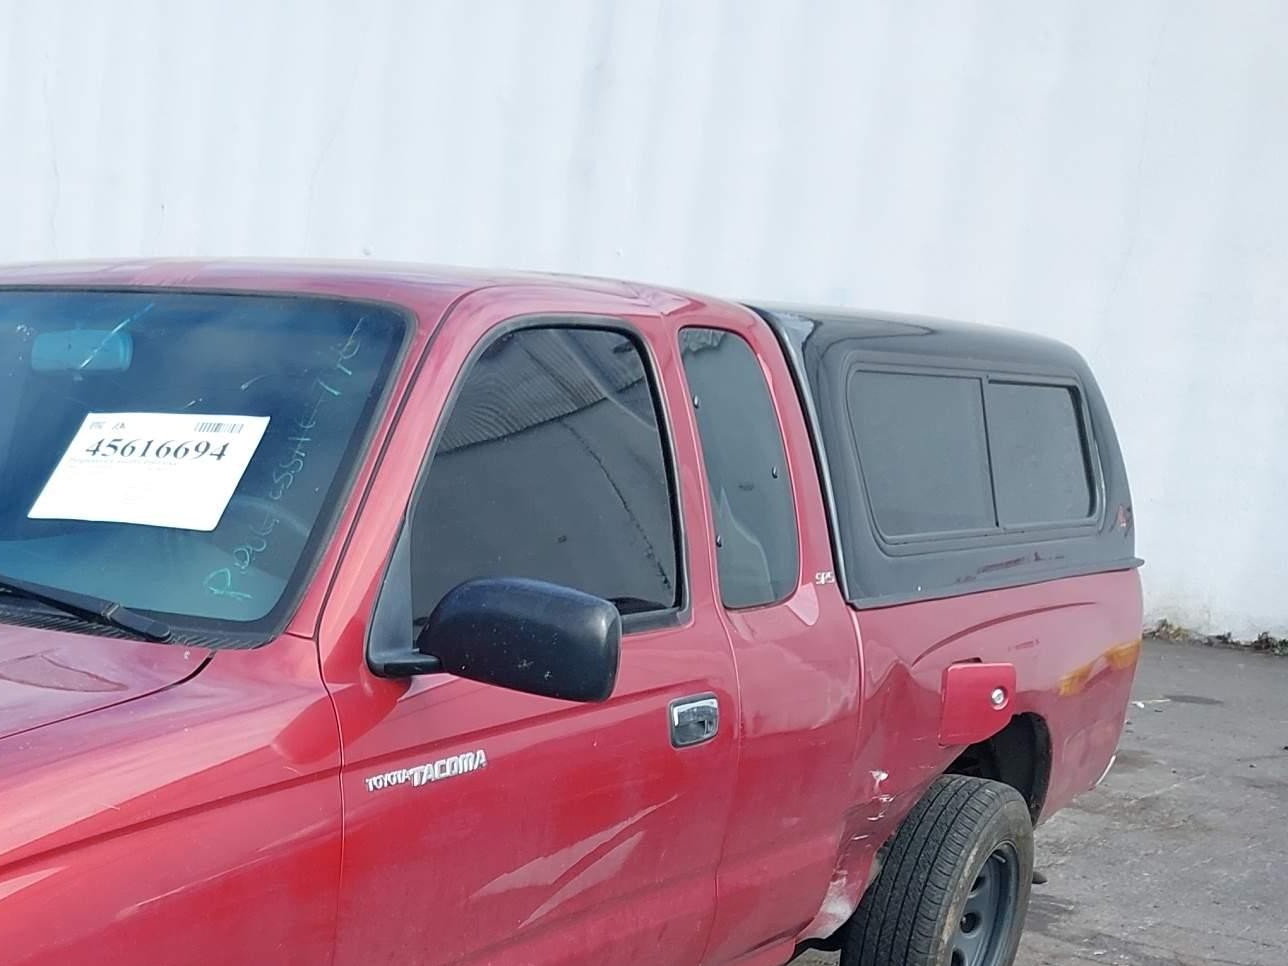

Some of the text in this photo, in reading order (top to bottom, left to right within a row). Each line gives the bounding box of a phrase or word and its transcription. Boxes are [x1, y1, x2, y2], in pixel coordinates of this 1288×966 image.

[85, 437, 231, 462] 45616694
[365, 749, 487, 792] TOYOTA TACOMA
